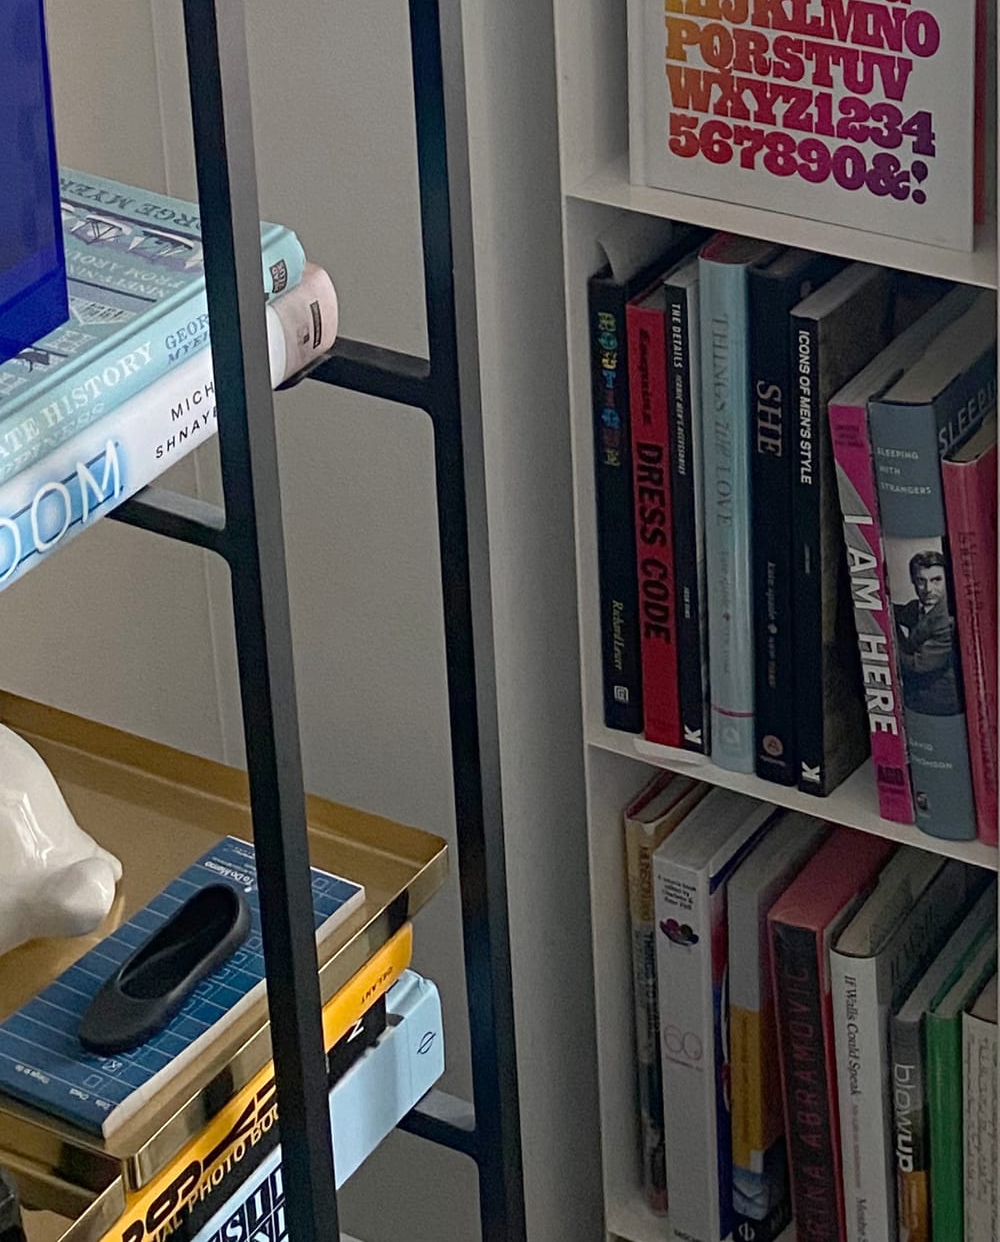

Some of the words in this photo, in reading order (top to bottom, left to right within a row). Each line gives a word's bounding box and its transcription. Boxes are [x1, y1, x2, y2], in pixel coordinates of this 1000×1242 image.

[665, 15, 913, 102] PQRSTUV
[665, 62, 936, 157] WXYZ1234
[670, 302, 681, 323] THE
[671, 325, 683, 367] DETAILS
[710, 312, 731, 411] THINGS
[798, 329, 810, 373] ICONS
[40, 342, 154, 427] HISTORY
[170, 381, 215, 422] MICH
[799, 373, 810, 394] OF
[757, 380, 781, 457] SHE
[799, 396, 812, 444] MEN'S
[800, 444, 812, 485] STYLE
[877, 447, 919, 460] SLEEPING
[878, 466, 901, 475] WITH
[636, 441, 667, 547] DRESS
[714, 464, 732, 526] LOVE
[880, 481, 932, 495] STRANGERS
[639, 557, 671, 645] CODE
[849, 549, 883, 611] AM
[859, 632, 899, 737] HERE
[685, 725, 702, 744] K
[801, 761, 820, 783] K
[843, 975, 856, 988] If
[844, 988, 858, 1021] Walls
[845, 1022, 859, 1058] Could
[846, 1060, 861, 1096] Speak
[893, 1062, 917, 1173] blowup
[188, 1143, 245, 1214] PHOTO
